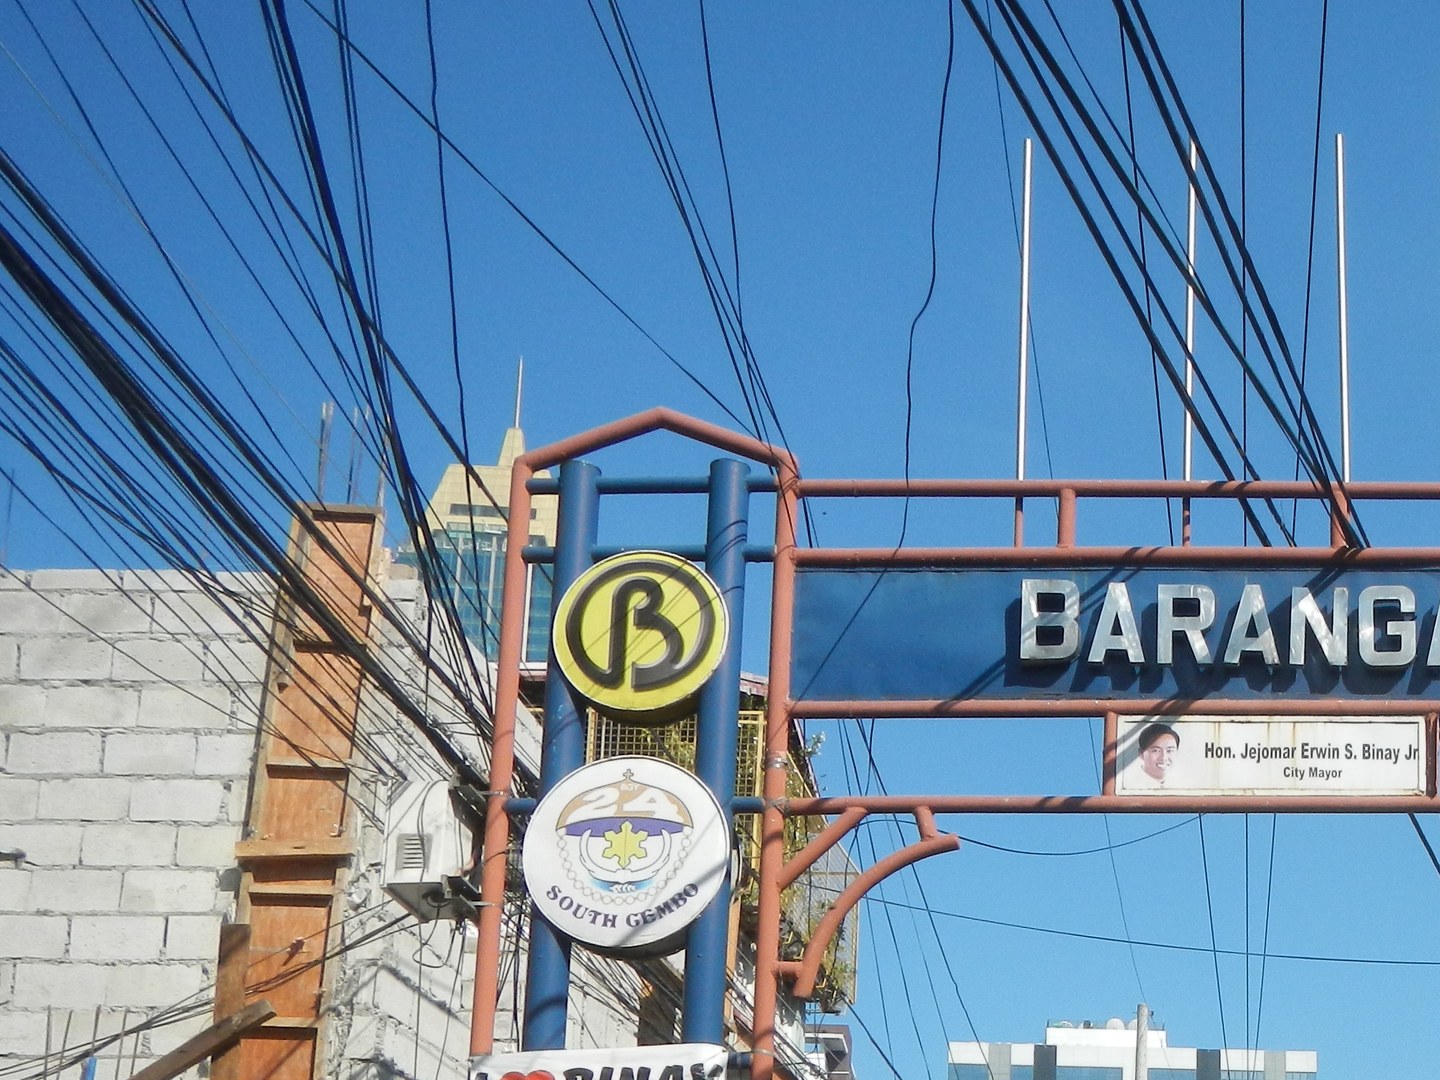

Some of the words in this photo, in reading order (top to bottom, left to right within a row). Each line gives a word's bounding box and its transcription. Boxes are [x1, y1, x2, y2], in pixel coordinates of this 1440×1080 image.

[1204, 742, 1236, 759] Hon.
[1240, 742, 1297, 764] Jejomar
[1301, 742, 1340, 760] Erwin
[1344, 743, 1357, 760] S.
[1362, 744, 1400, 764] Binay
[1283, 766, 1305, 780] City
[1308, 767, 1342, 780] Mayor
[620, 784, 640, 792] BGY
[565, 787, 686, 825] 24
[546, 885, 618, 928] SOUTH
